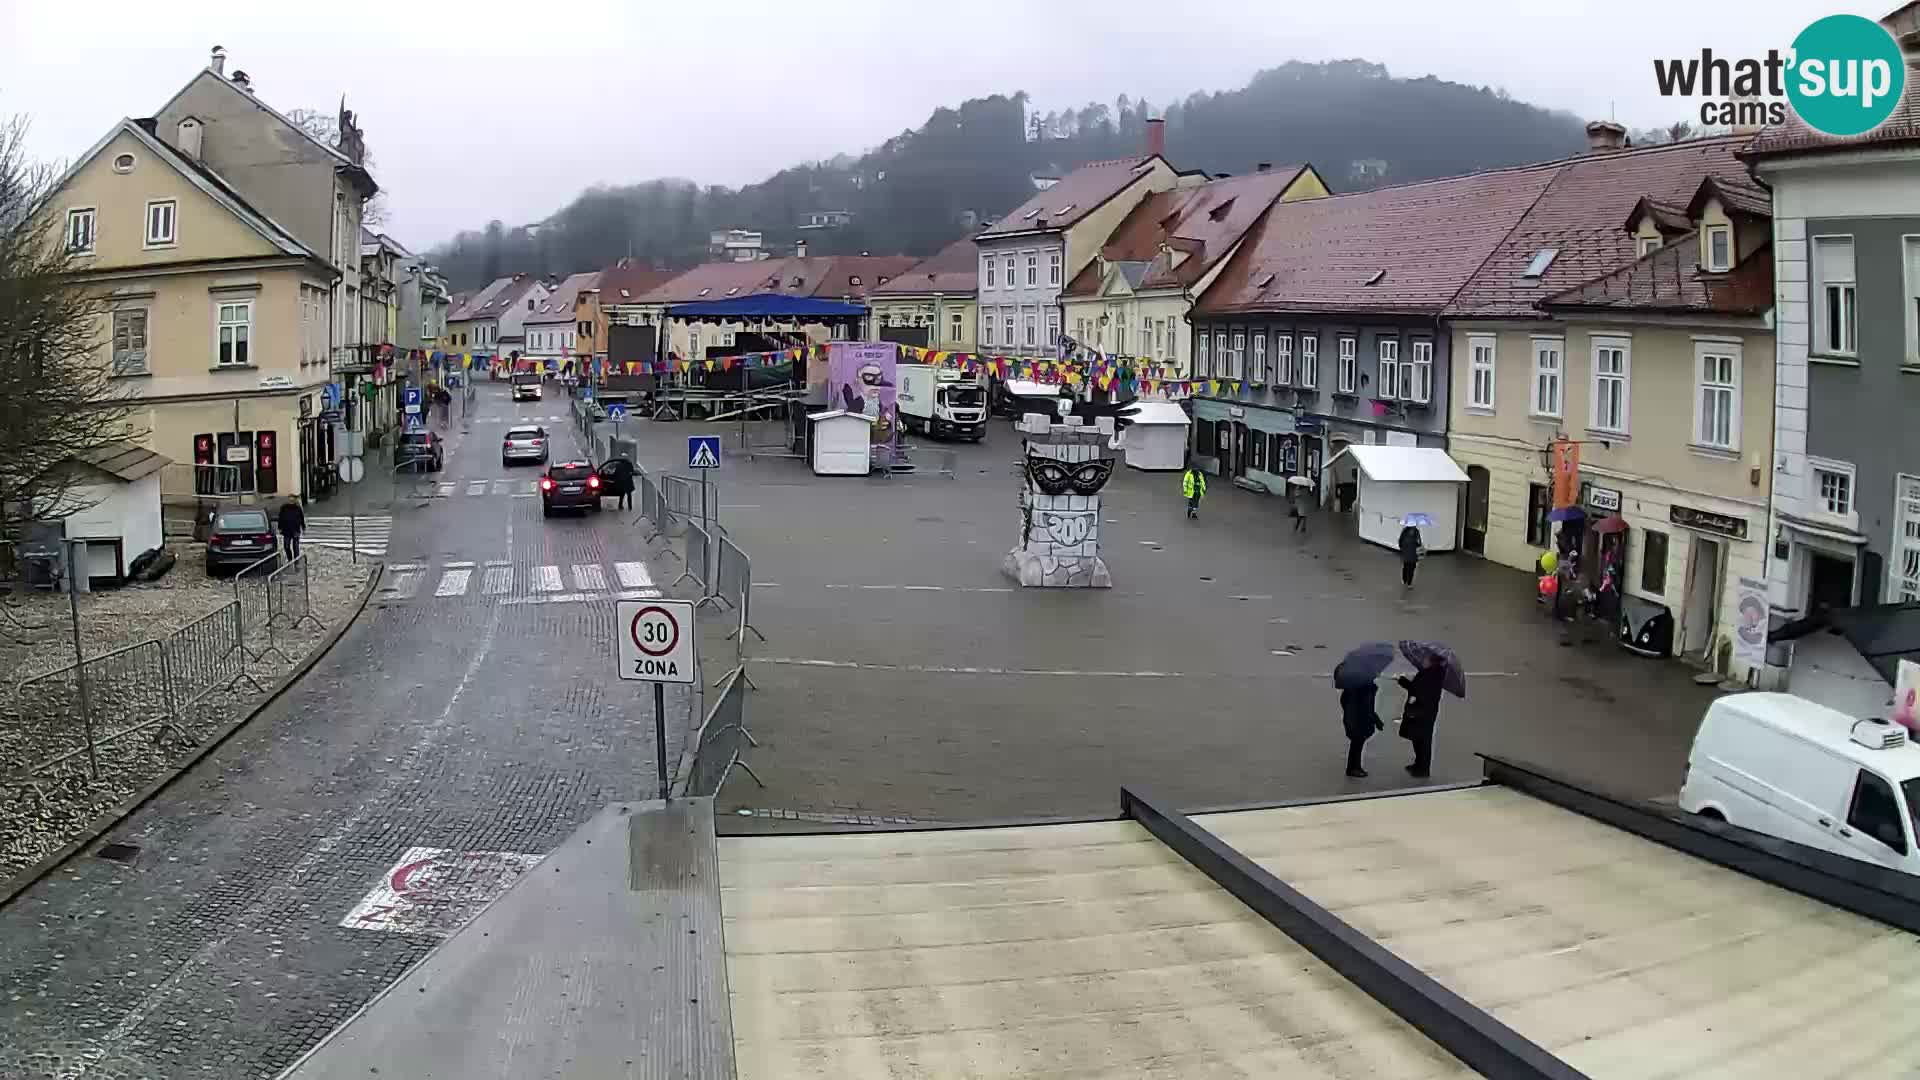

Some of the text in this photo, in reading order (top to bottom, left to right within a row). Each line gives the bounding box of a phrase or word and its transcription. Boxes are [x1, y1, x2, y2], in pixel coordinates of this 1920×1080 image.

[1049, 516, 1086, 545] 200
[644, 622, 668, 643] 30
[634, 659, 678, 676] ZONA
